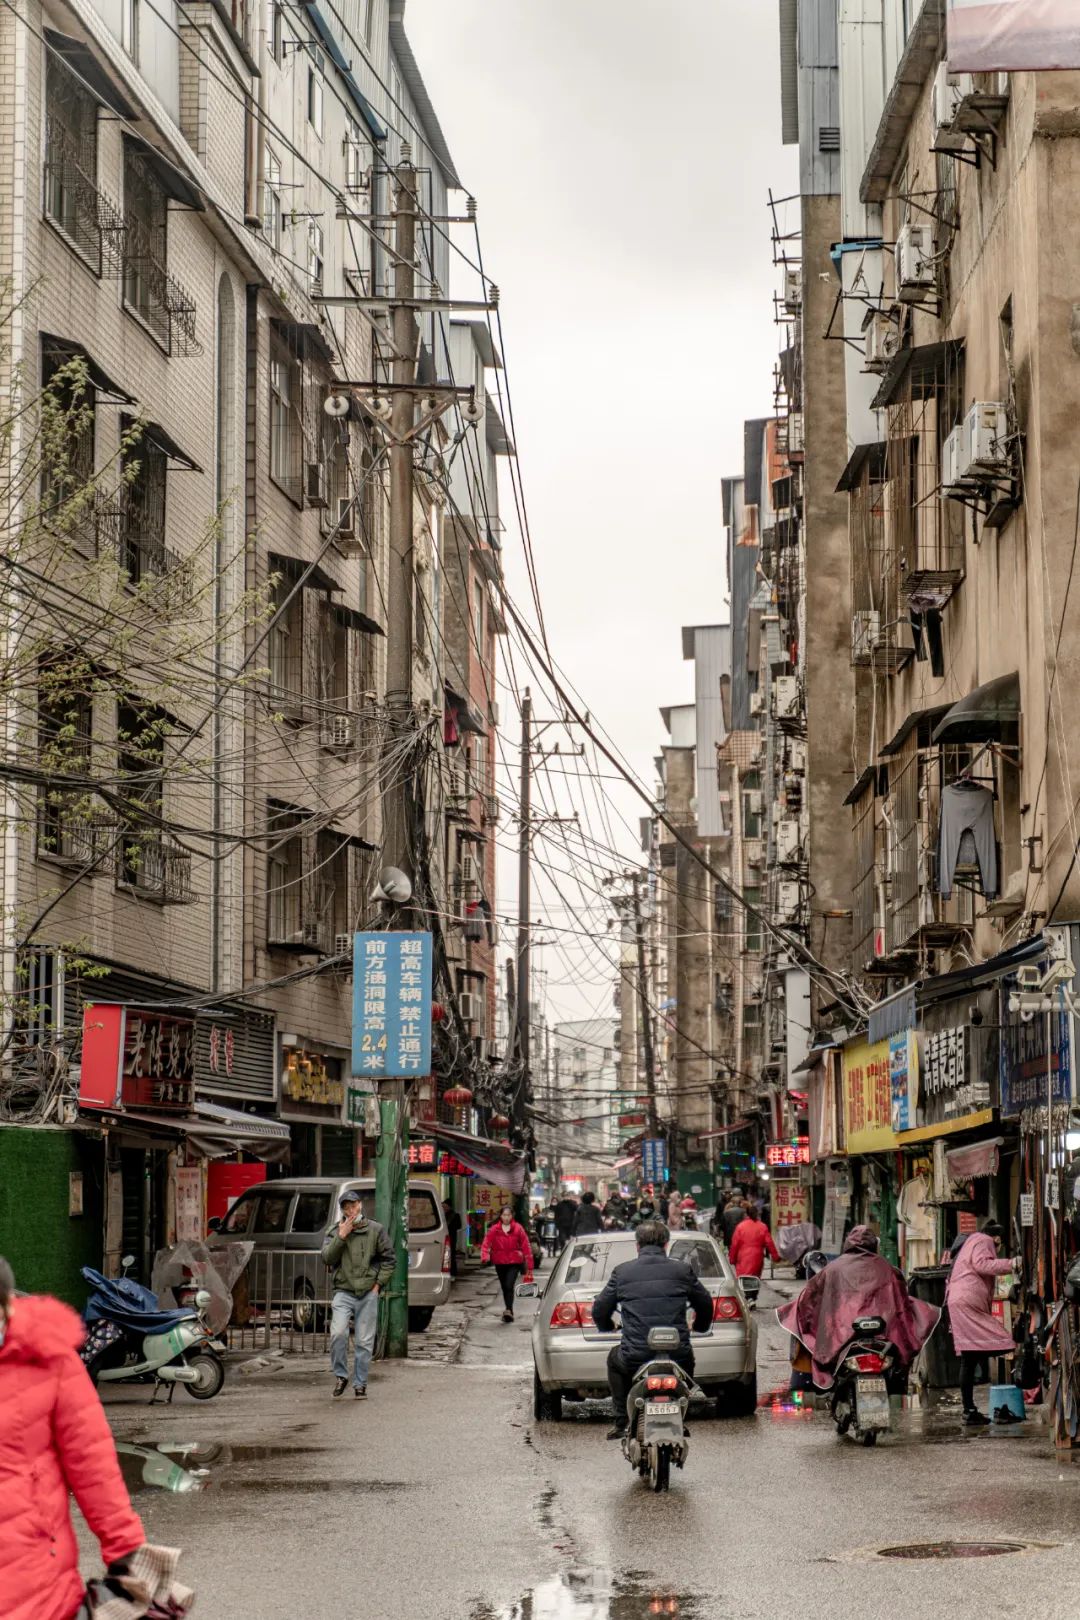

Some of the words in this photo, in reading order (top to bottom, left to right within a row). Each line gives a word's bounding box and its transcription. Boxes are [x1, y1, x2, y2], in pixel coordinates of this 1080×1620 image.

[361, 939, 388, 1070] 前方涵洞限高2.4米
[399, 939, 423, 1069] 超高车辆禁止通行
[776, 1184, 807, 1207] 福兴
